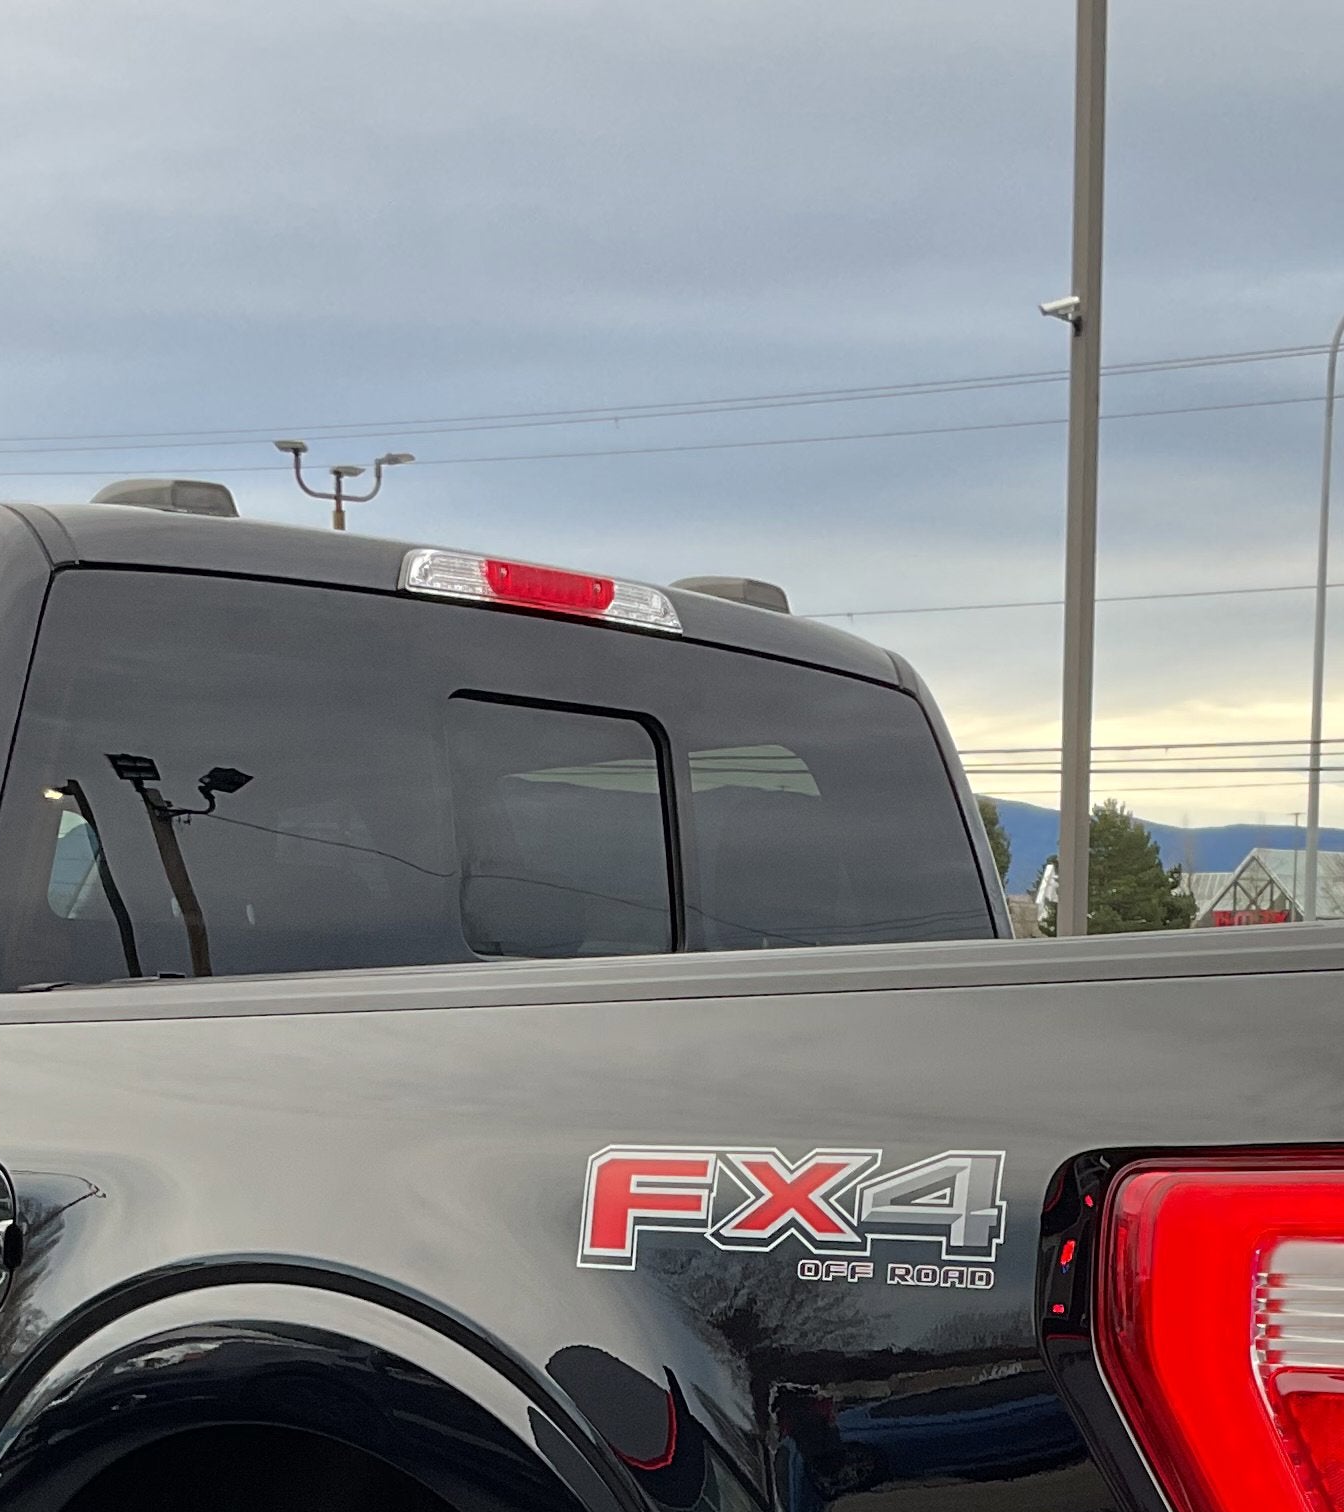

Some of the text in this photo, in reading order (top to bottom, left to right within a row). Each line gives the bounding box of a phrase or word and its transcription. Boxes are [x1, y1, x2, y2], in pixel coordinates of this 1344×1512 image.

[577, 1145, 1006, 1271] FX4
[797, 1259, 995, 1289] OFF ROAD
